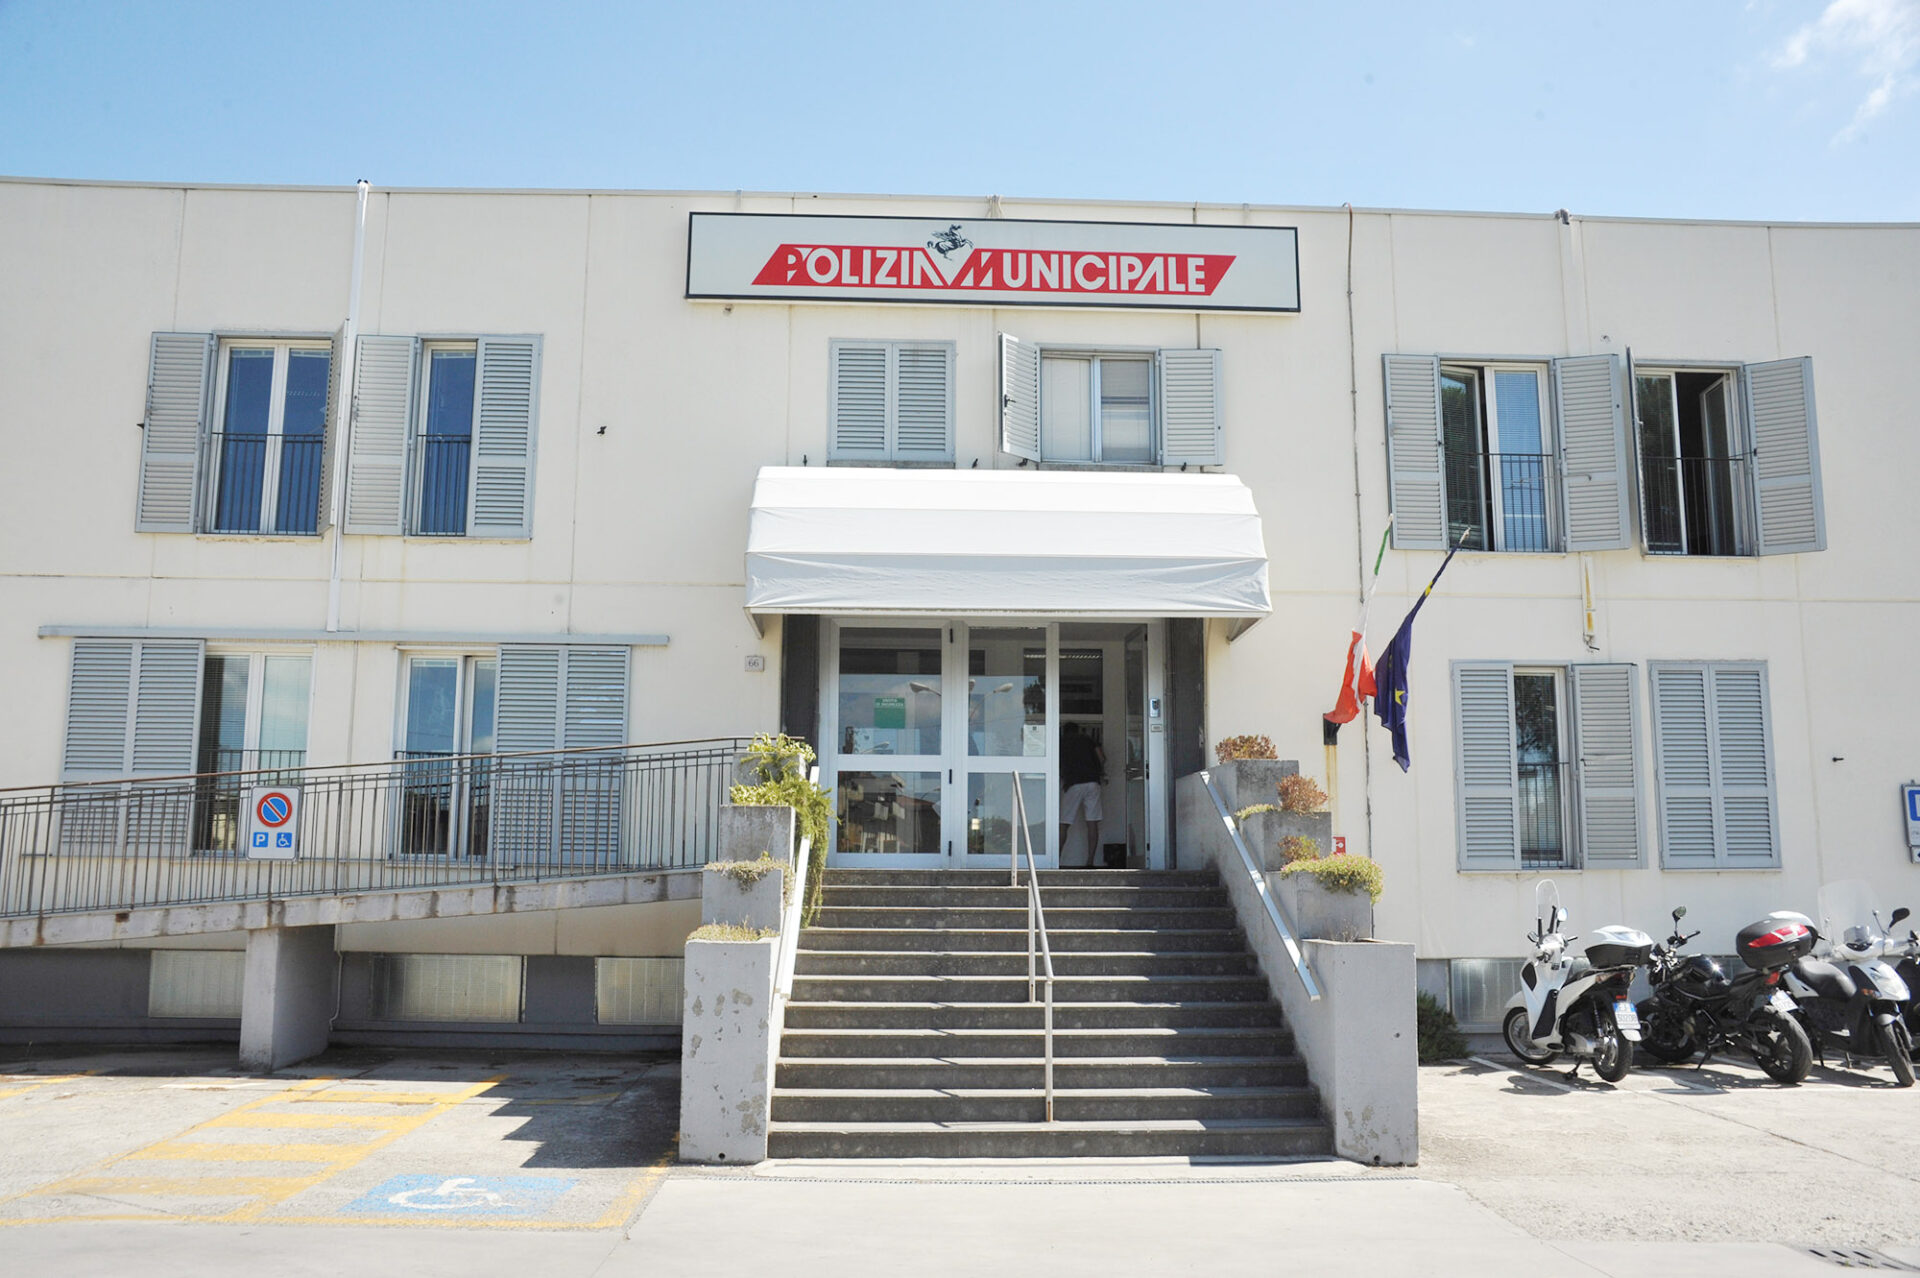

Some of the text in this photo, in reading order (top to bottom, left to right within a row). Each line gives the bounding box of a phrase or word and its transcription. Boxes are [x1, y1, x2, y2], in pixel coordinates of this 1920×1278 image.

[780, 246, 1206, 293] POLIZIA MUNICIPALE
[256, 834, 266, 846] P
